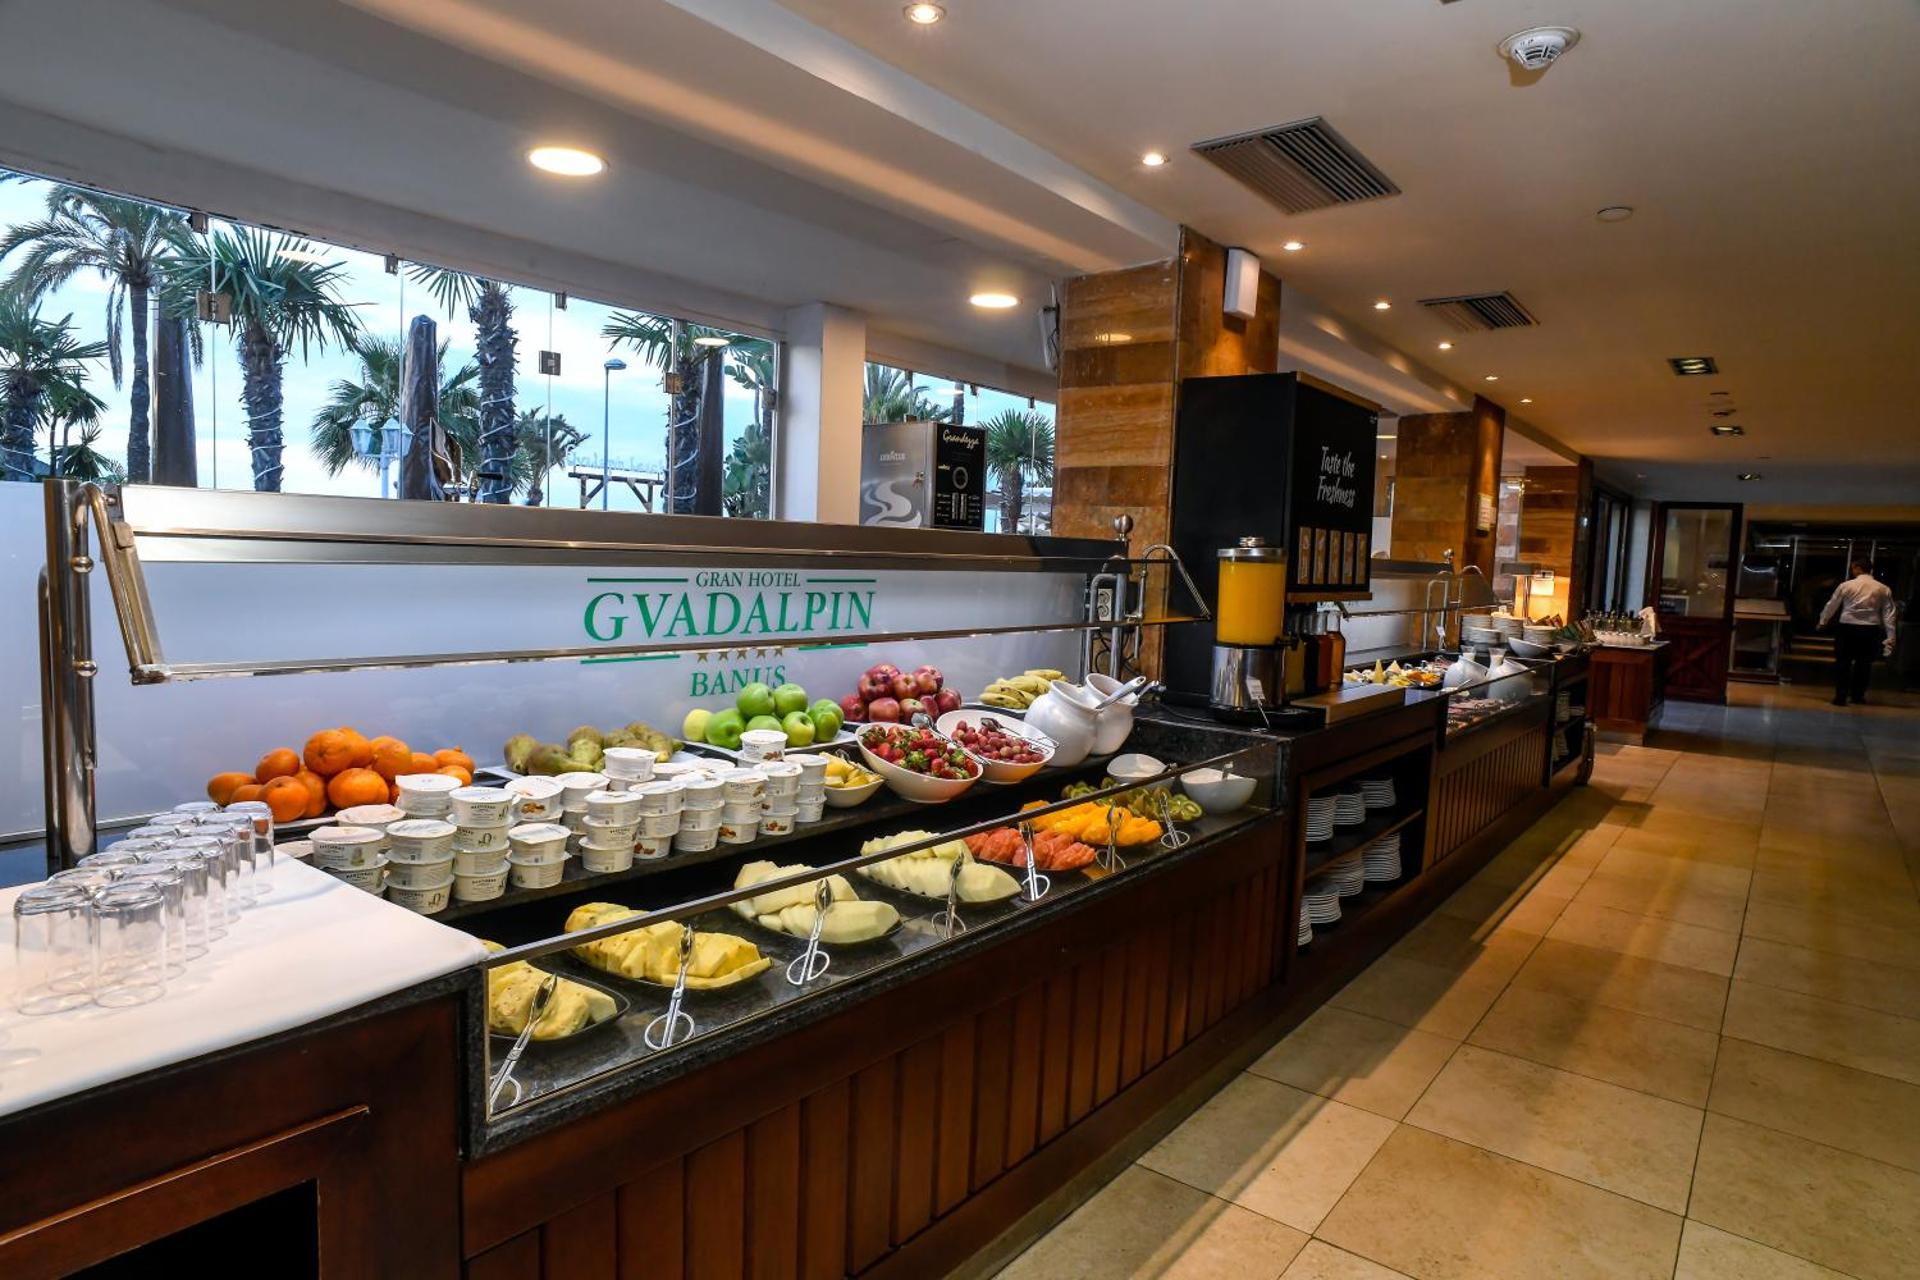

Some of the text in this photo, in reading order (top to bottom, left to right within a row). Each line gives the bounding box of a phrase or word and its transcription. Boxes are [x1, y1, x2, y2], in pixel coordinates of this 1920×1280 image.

[1321, 446, 1355, 478] Taste the
[1317, 476, 1356, 508] Freshness
[695, 571, 801, 587] GRAN HOTEL
[584, 591, 877, 641] GVADALPIN
